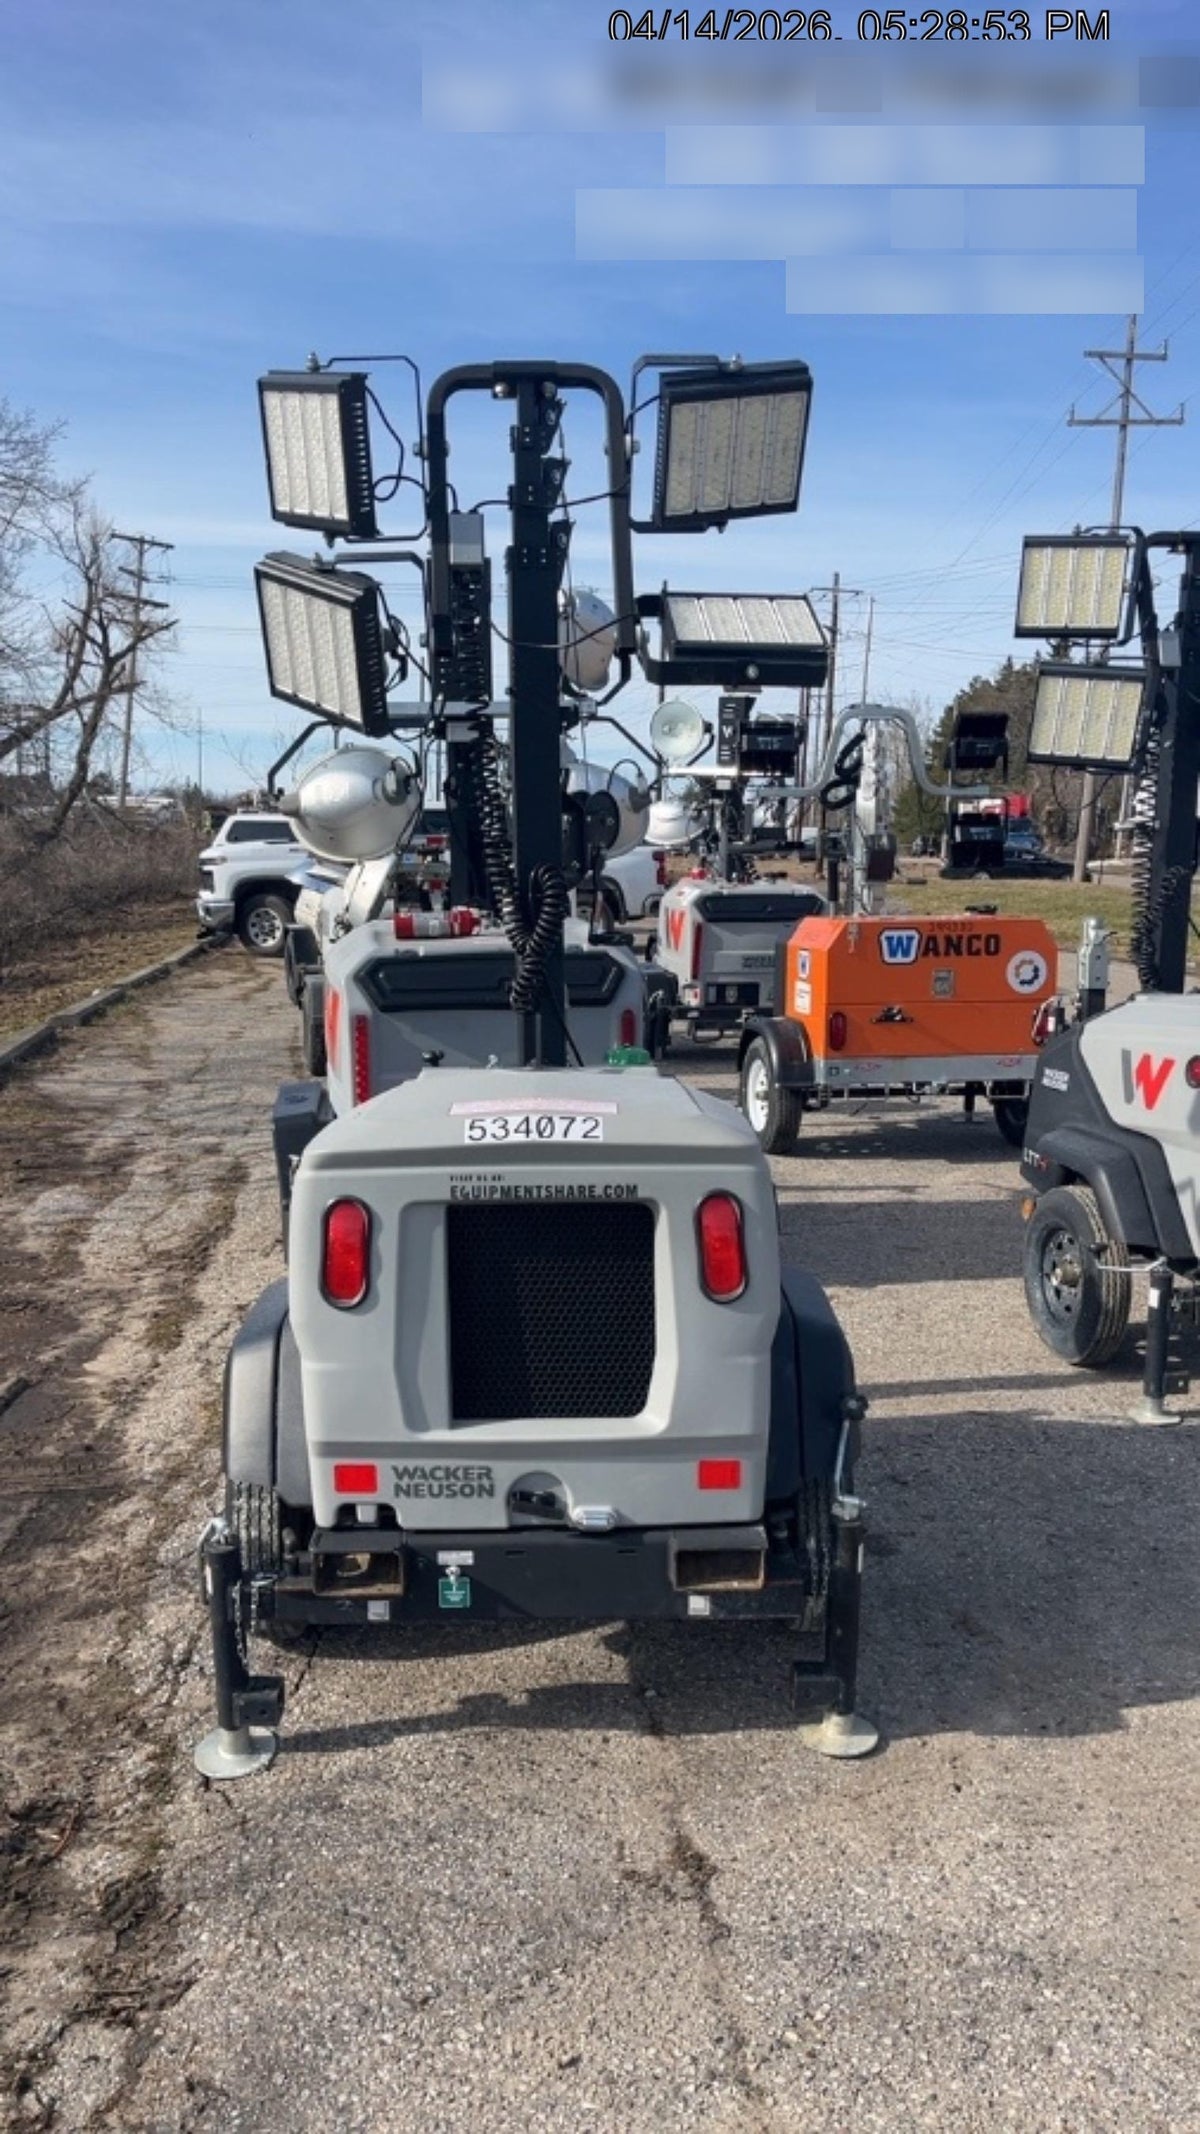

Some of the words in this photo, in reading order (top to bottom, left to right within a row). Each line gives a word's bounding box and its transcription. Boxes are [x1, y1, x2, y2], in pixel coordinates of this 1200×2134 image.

[883, 932, 1001, 959] WANCO
[468, 1115, 600, 1141] 534072
[450, 1184, 639, 1199] EQUIPMENTSHARE.COM
[392, 1466, 492, 1480] WACKER
[394, 1483, 495, 1498] NEUSON
